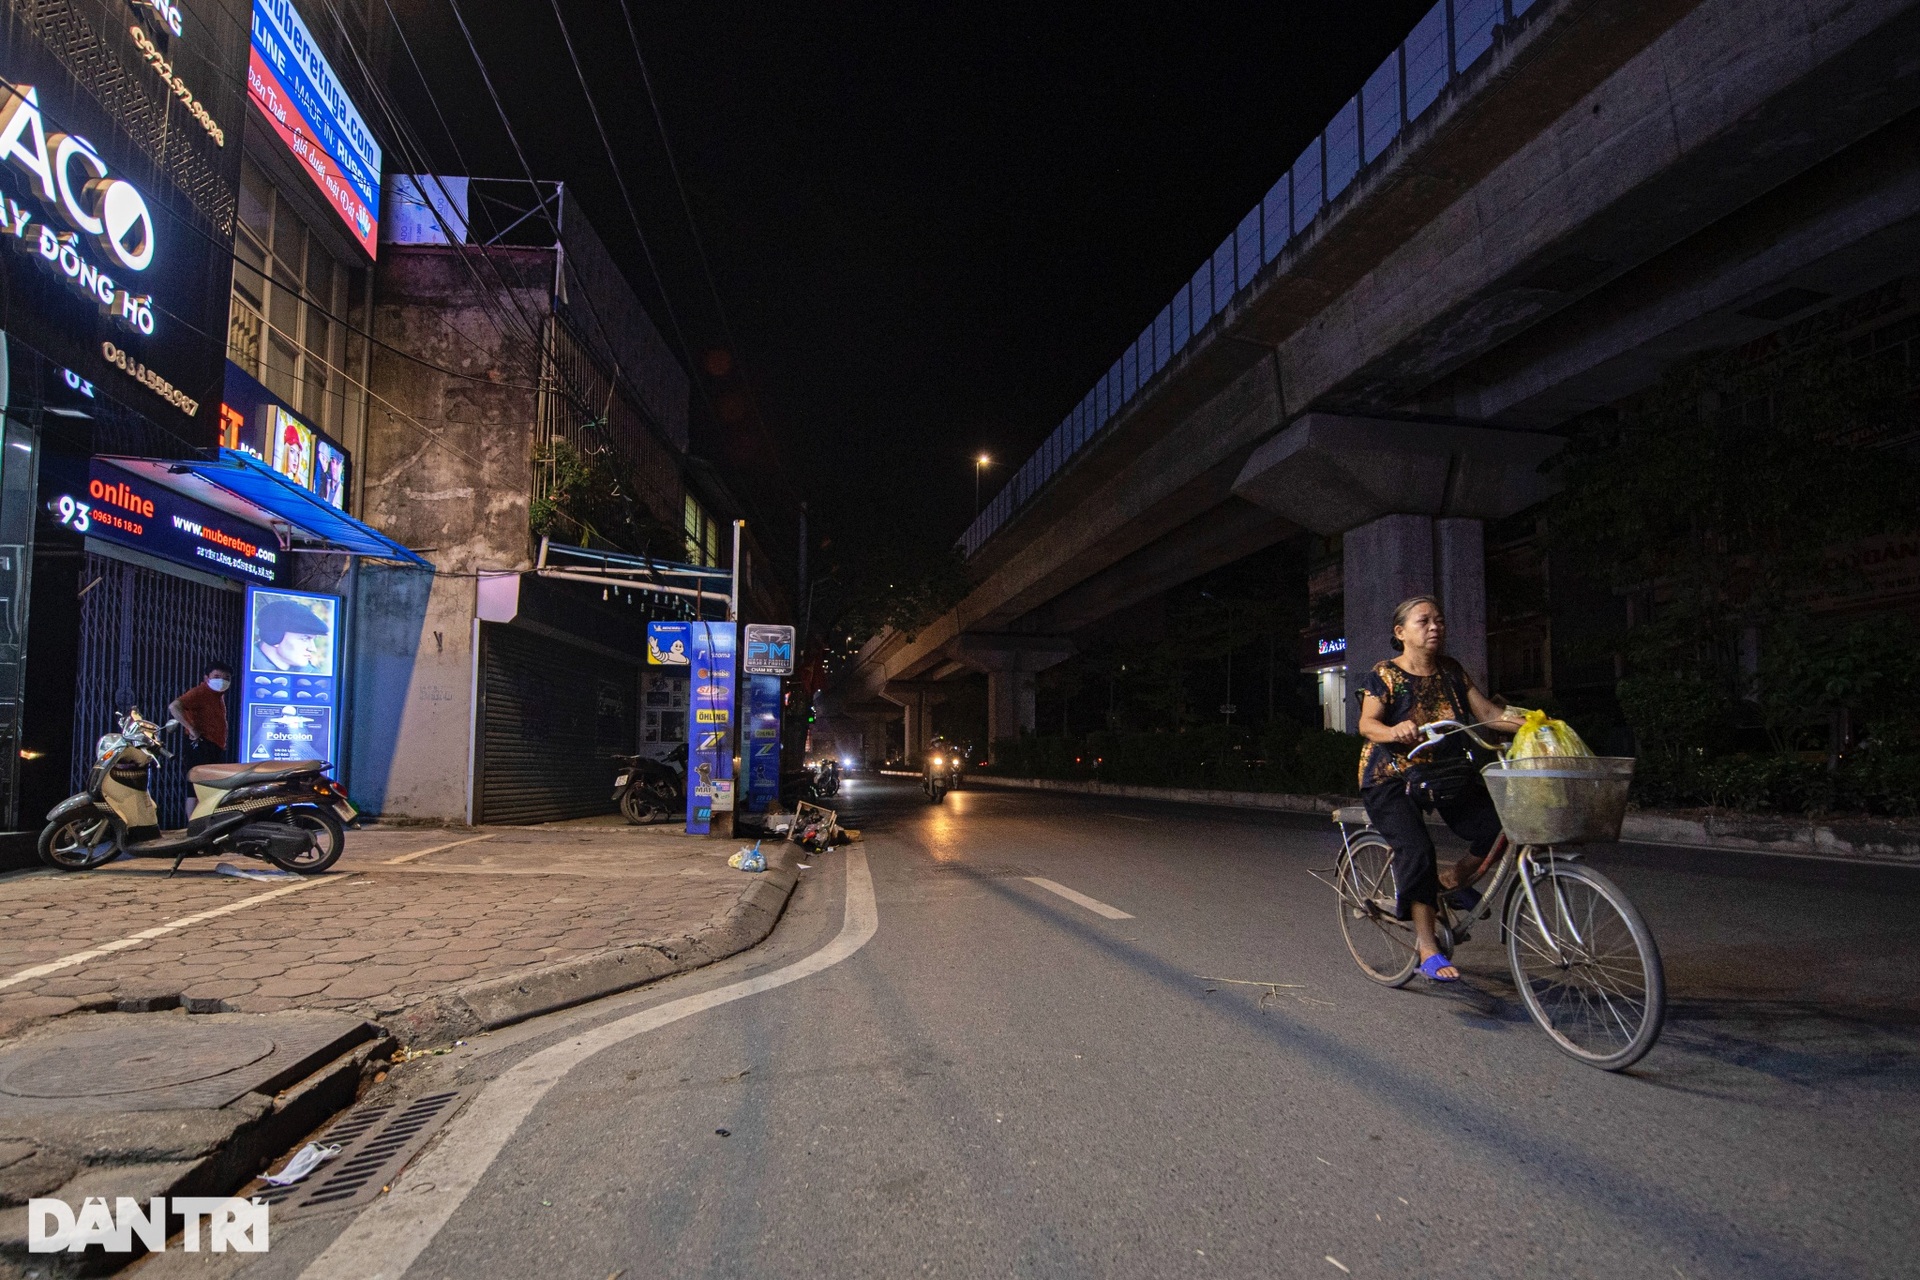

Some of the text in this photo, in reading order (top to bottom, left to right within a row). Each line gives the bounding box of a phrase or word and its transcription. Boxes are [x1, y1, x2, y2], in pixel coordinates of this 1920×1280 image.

[294, 75, 323, 130] MADE
[337, 140, 373, 203] RUSSIA
[39, 225, 115, 305] ĐỒNG
[122, 291, 155, 335] HỒ
[60, 496, 90, 532] 93
[89, 480, 154, 518] online
[113, 516, 122, 529] 16
[124, 520, 132, 532] 18
[133, 524, 143, 535] 20
[173, 515, 276, 564] www.muberetnga.com
[748, 642, 791, 660] PM
[698, 710, 726, 721] ÖHLNS
[266, 731, 313, 742] Polycolon
